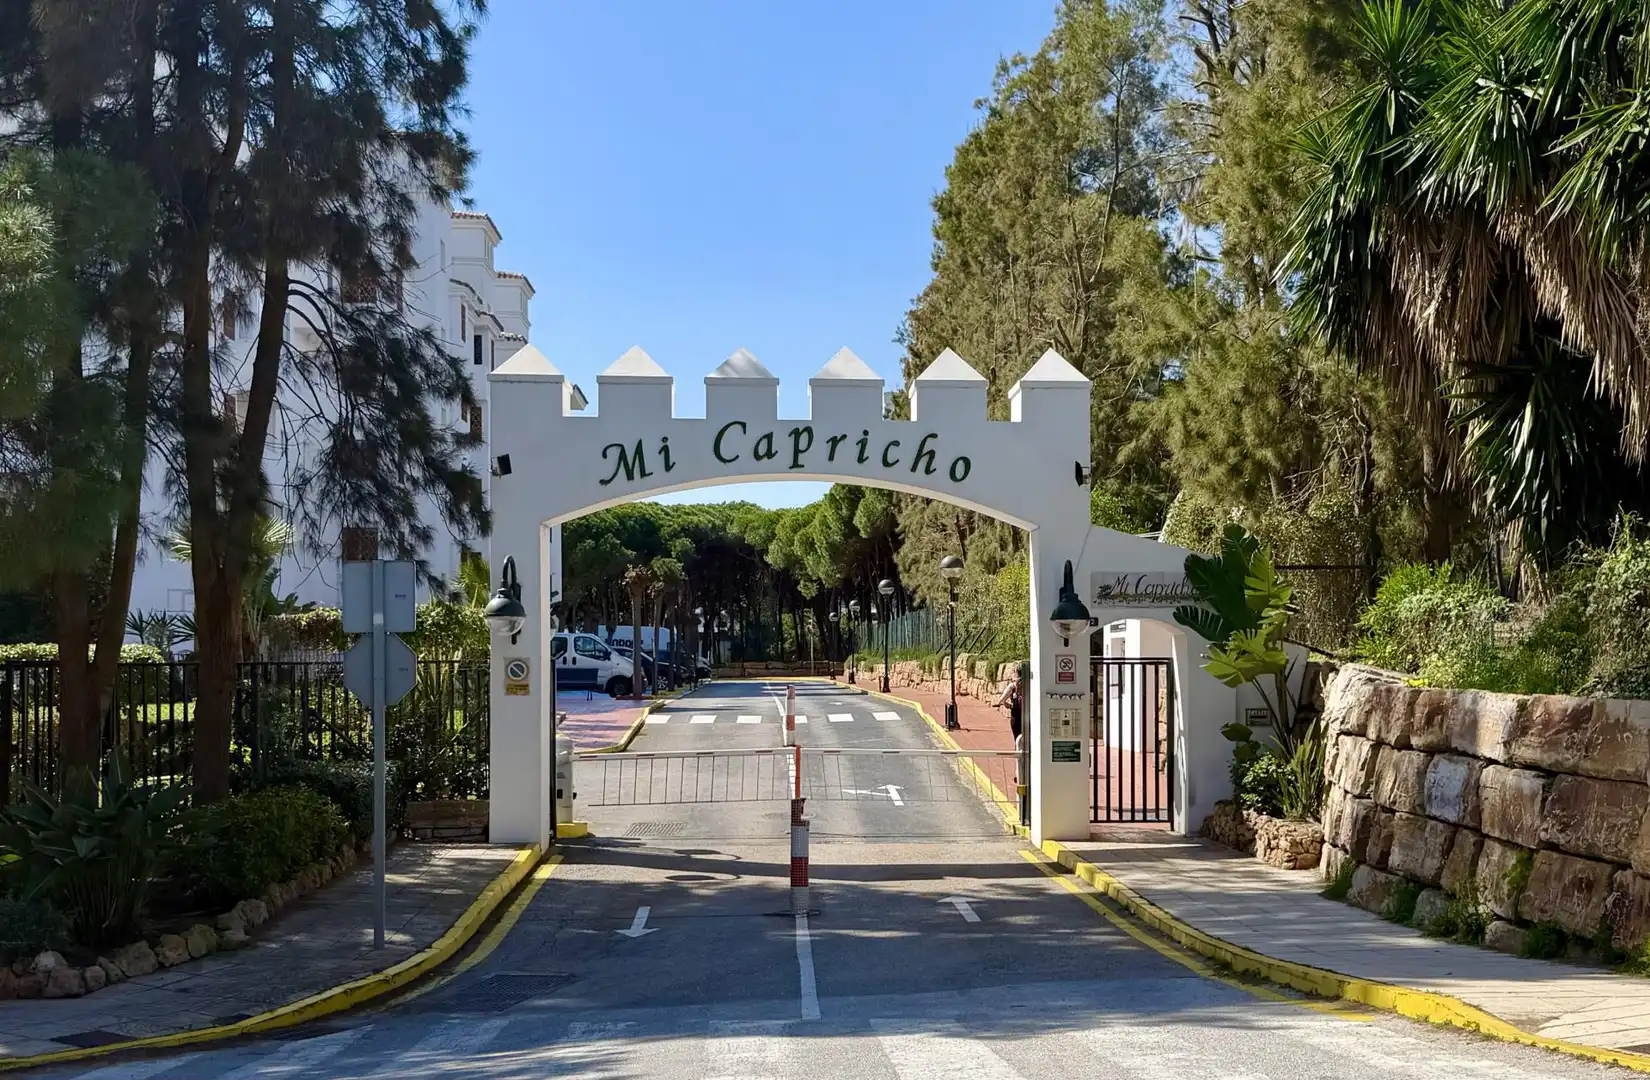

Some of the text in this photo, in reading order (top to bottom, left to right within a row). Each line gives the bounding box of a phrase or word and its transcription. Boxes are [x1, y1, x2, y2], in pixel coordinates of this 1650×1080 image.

[598, 420, 972, 486] Mi Capricho
[1108, 573, 1129, 596] Mi
